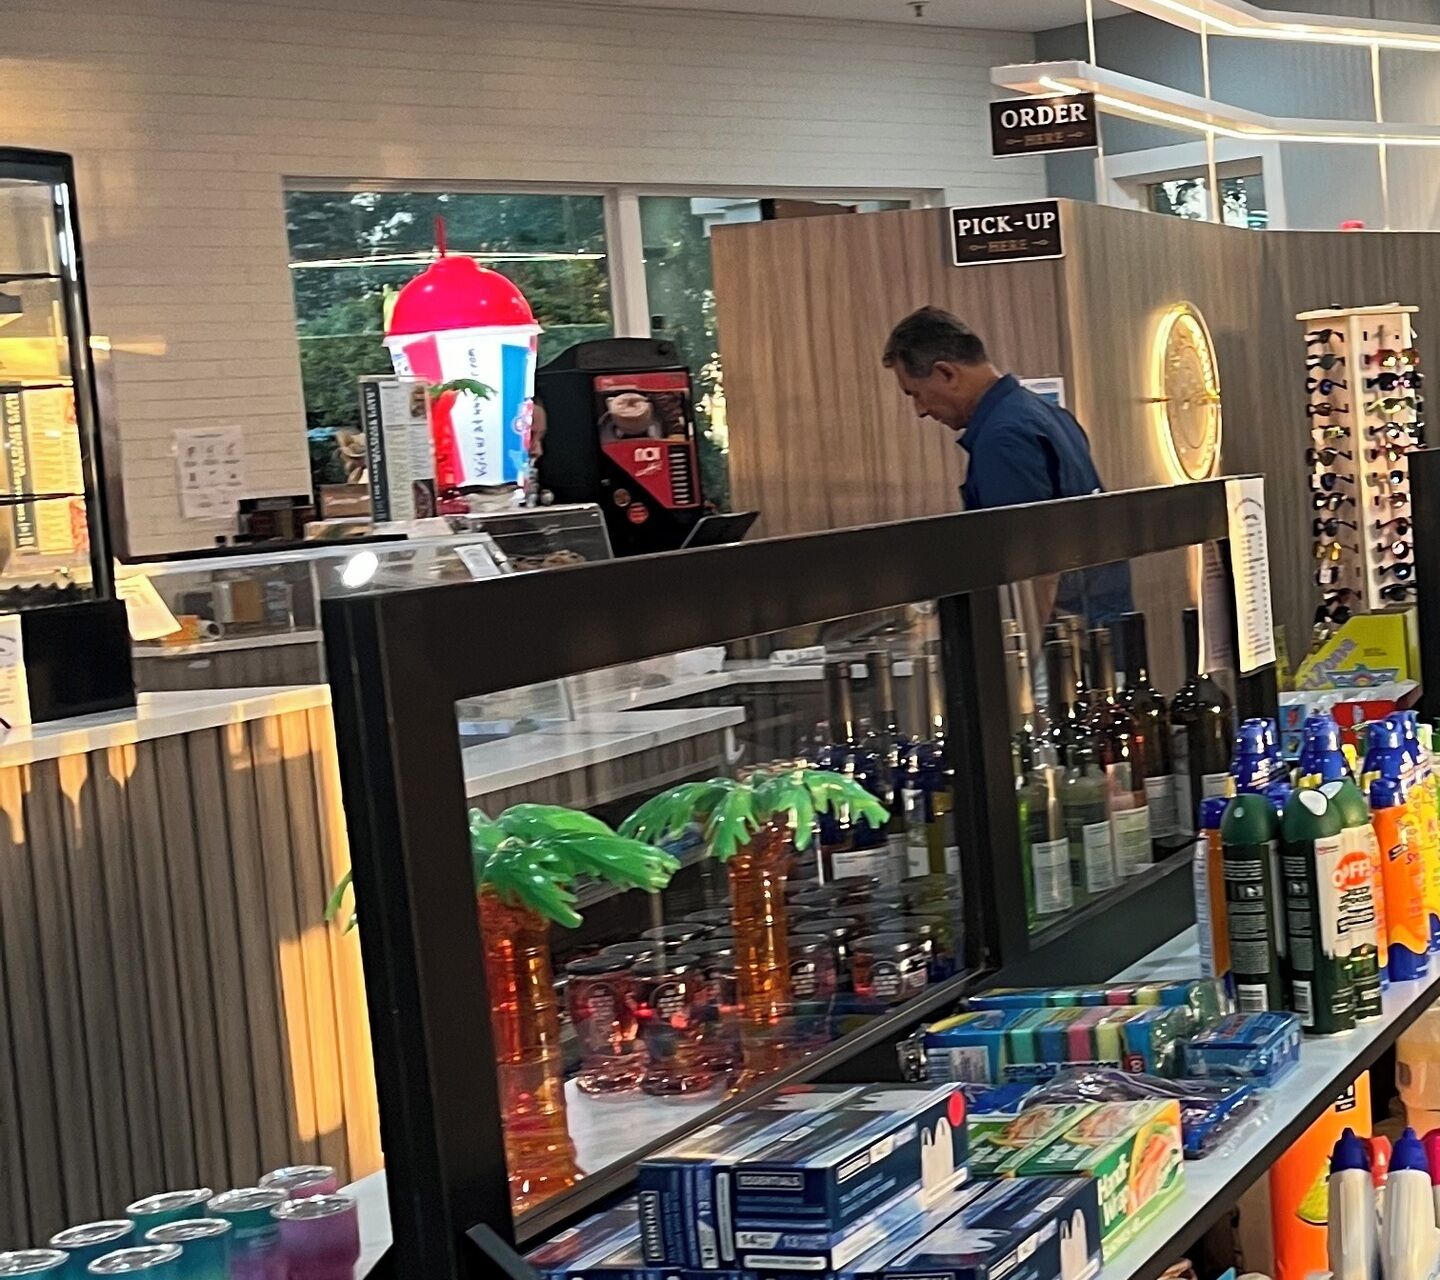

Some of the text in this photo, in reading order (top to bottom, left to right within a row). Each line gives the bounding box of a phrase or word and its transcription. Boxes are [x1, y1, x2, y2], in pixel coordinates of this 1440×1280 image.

[1000, 103, 1088, 129] ORDER
[957, 211, 1057, 237] PICK-UP
[644, 1194, 660, 1258] ESSENTIALS
